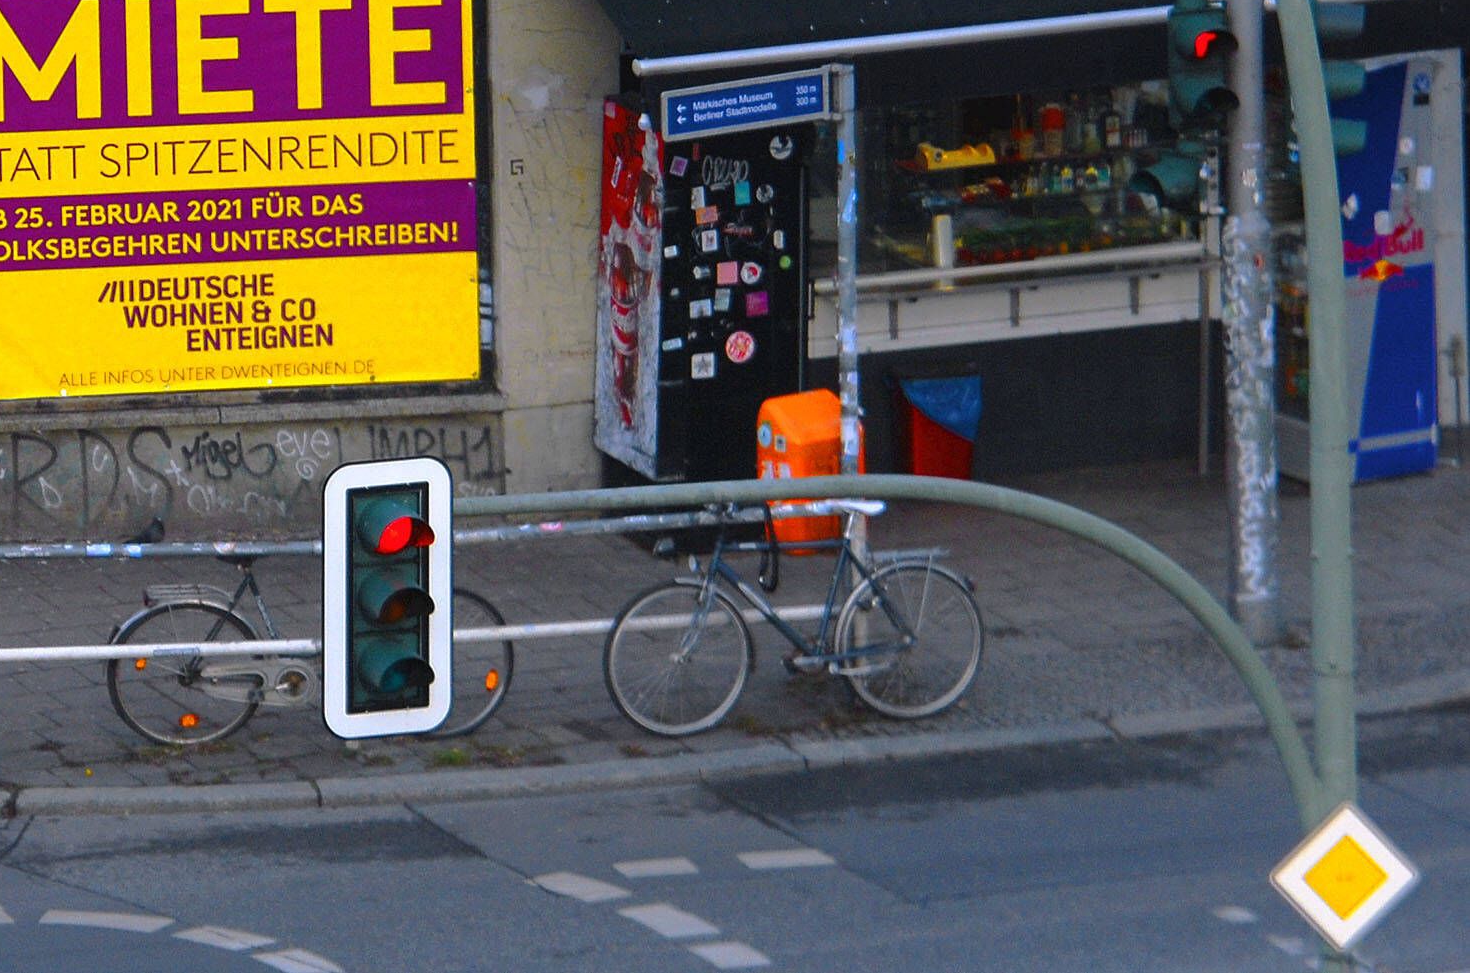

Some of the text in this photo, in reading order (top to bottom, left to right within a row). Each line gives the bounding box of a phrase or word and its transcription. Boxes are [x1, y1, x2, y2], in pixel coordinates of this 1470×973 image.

[692, 96, 737, 111] Märkisches
[738, 91, 773, 103] Museum
[693, 110, 725, 123] Berliner
[99, 129, 460, 179] SPITZENRENDITE
[14, 205, 53, 228] 25.
[61, 199, 180, 227] FEBRUAR
[187, 197, 243, 222] 2021
[251, 191, 303, 218] FÜR
[312, 194, 364, 216] DAS
[210, 221, 459, 254] UNTERSCHREIBEN!
[138, 273, 275, 303] DEUTSCHE
[122, 297, 317, 329] WOHNEN & CO
[186, 323, 334, 352] ENTEIGNEN
[58, 371, 97, 387] ALLE
[103, 368, 154, 385] INFOS
[158, 365, 216, 383] UNTER
